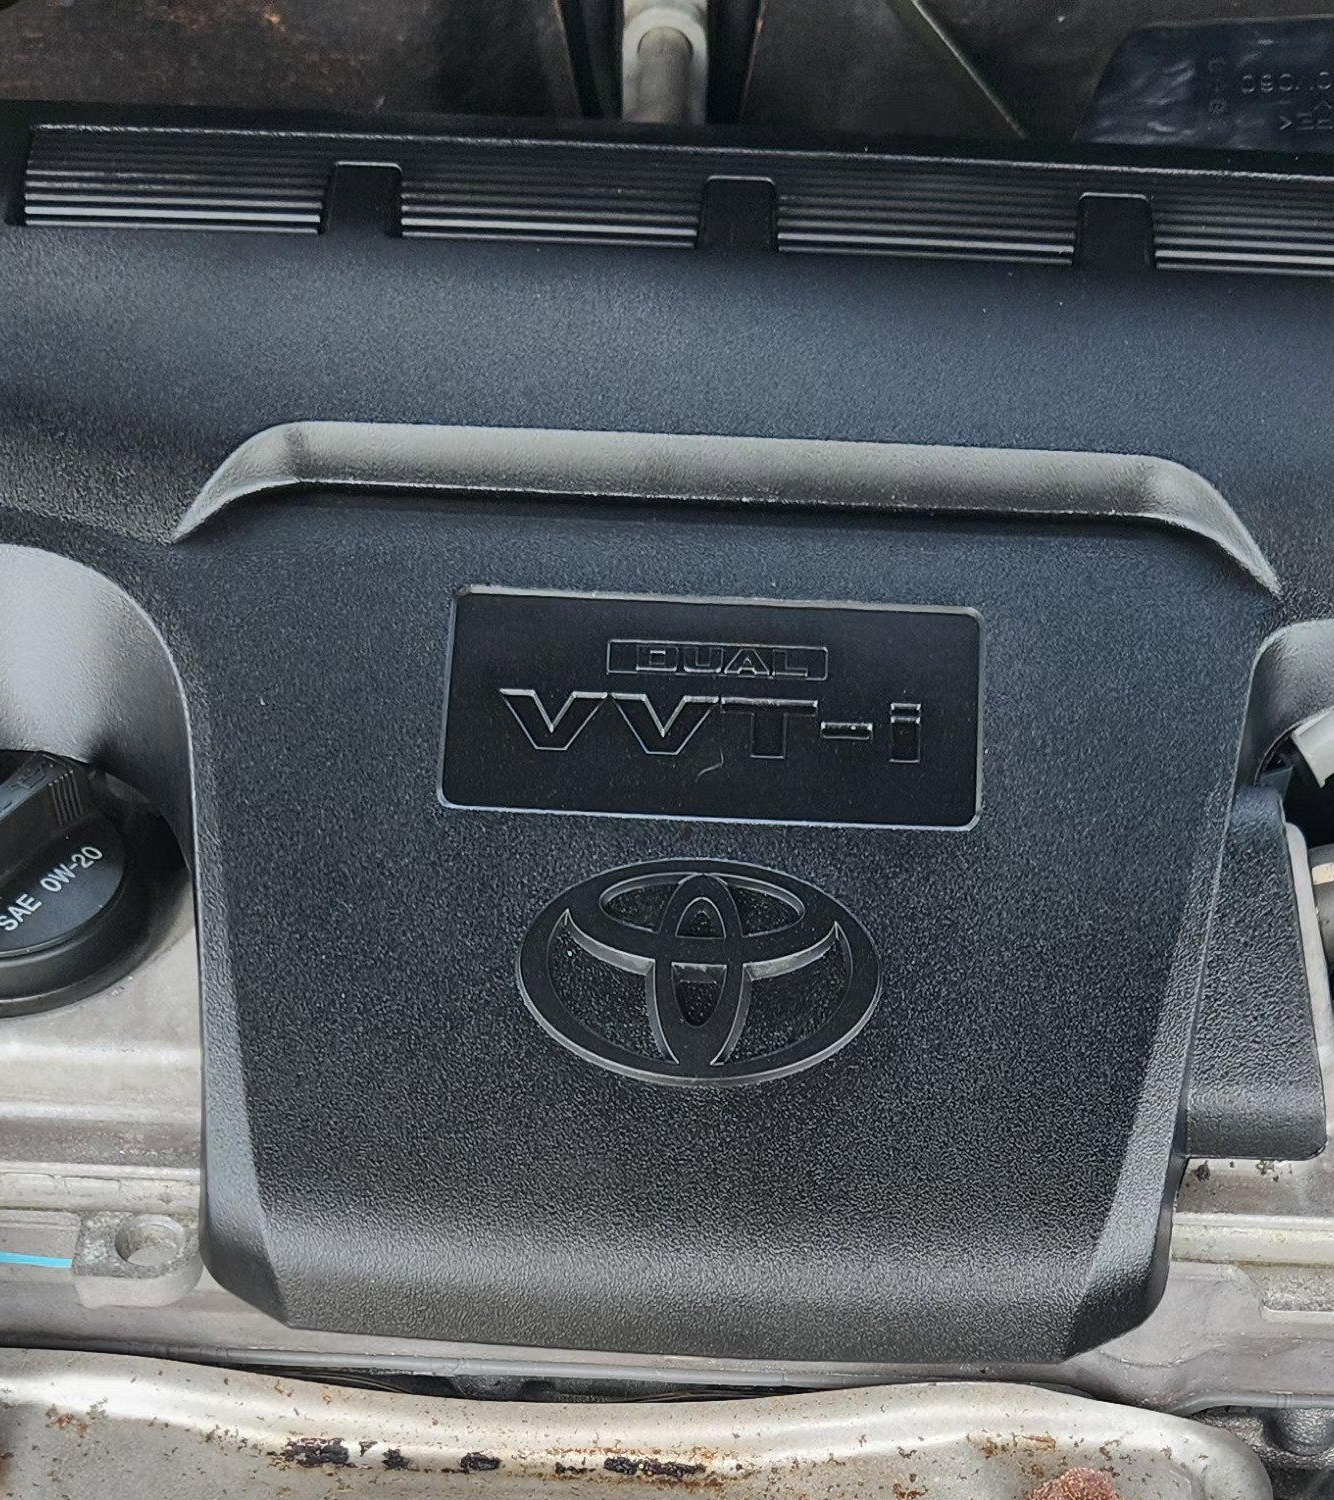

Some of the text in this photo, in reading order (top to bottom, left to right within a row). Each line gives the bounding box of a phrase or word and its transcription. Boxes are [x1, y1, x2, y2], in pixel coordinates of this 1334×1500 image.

[634, 644, 809, 679] DUAL
[499, 687, 922, 764] VVT-i
[39, 845, 103, 893] 0W-20
